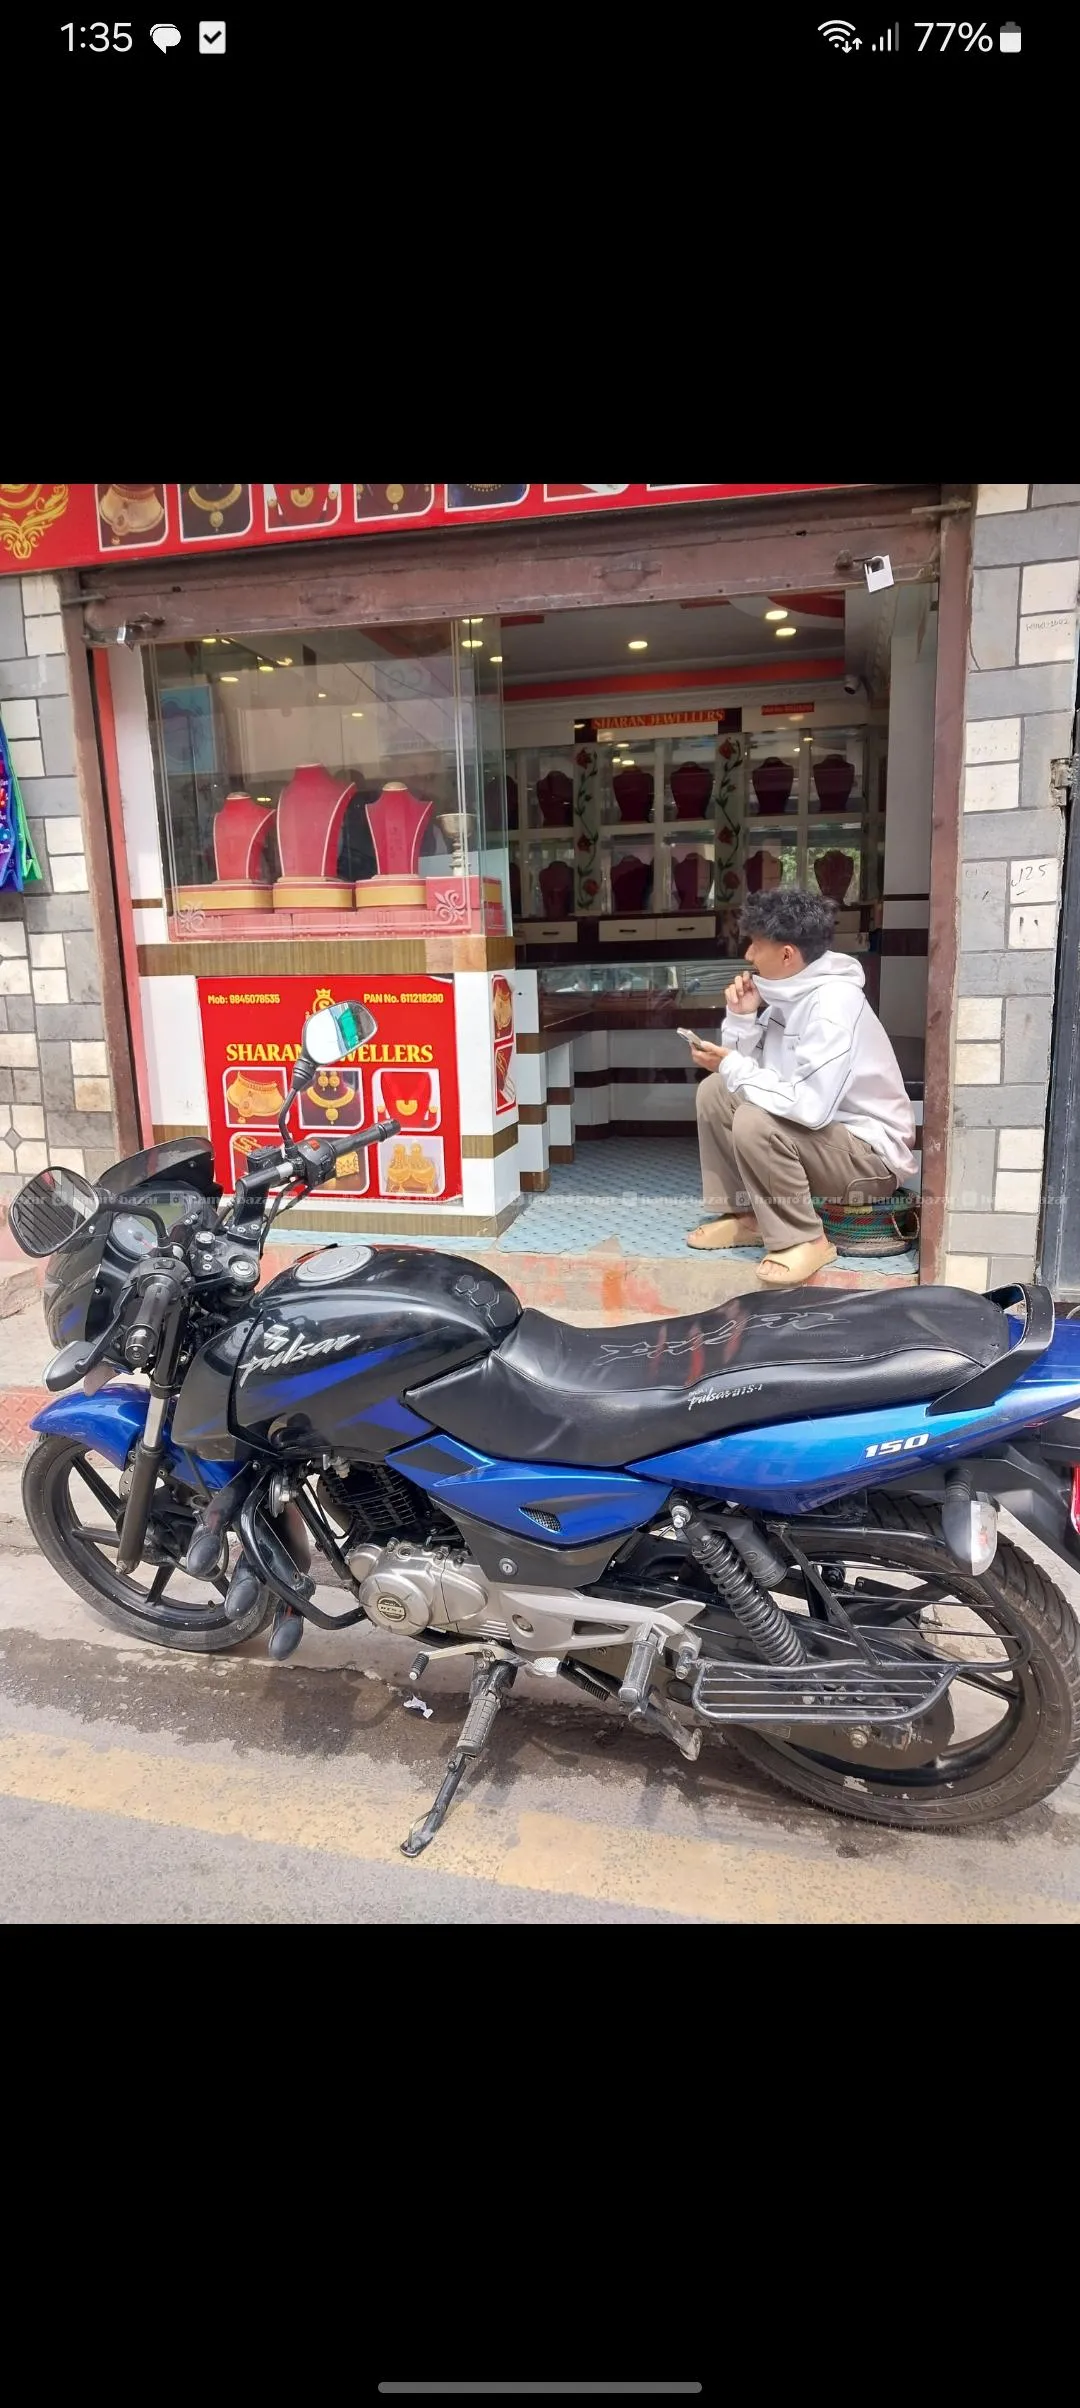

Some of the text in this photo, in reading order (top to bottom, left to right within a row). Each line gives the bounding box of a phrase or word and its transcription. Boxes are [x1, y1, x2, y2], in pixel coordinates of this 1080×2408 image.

[593, 715, 646, 728] SHARAN
[208, 994, 228, 1004] Mob:
[363, 993, 383, 1004] PAN
[383, 993, 399, 1004] No.
[865, 1433, 930, 1458] 150
